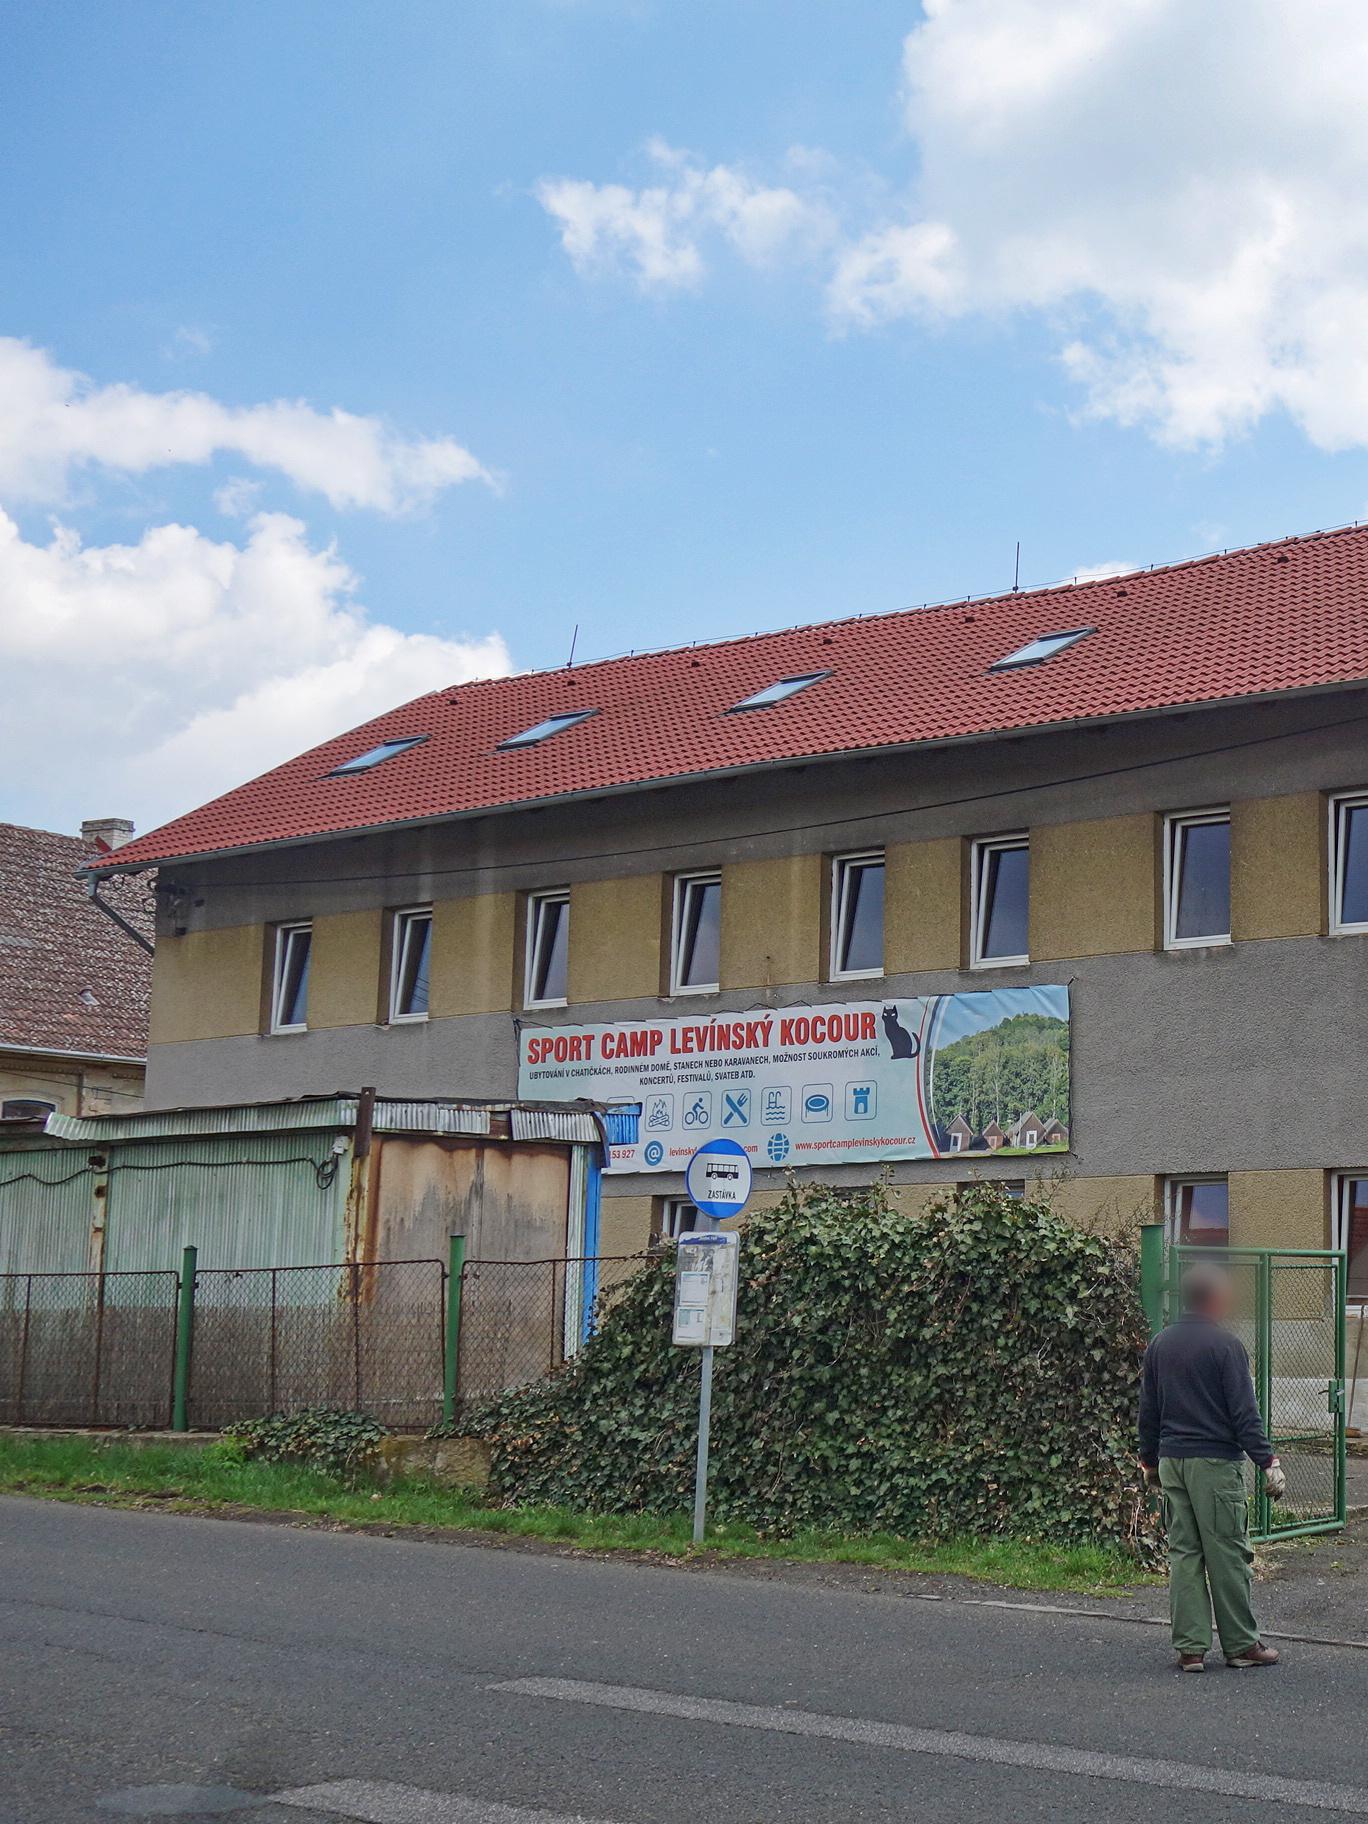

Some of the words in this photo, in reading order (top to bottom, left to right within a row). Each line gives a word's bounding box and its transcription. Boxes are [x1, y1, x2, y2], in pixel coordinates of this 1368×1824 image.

[527, 1034, 595, 1065] SPORT
[601, 1030, 663, 1060] CAMP
[670, 1013, 773, 1055] LEVÍNSKÝ
[780, 1011, 877, 1046] KOCOUR
[529, 1068, 565, 1080] UBYTOVÁNÍ
[565, 1070, 571, 1078] V
[571, 1065, 613, 1077] CHATIČKÁCH,
[614, 1062, 649, 1074] RODINNÉM
[673, 1060, 703, 1071] STANECH
[704, 1058, 723, 1068] NEBO
[724, 1056, 771, 1067] KARAVANECH,
[772, 1051, 807, 1063] MOŽNOST
[807, 1047, 859, 1061] SOUKROMÝCH
[715, 1070, 740, 1081] SVATEB
[740, 1069, 756, 1079] ATD.
[795, 1136, 916, 1151] www.sportcamplevinskykocour.cz
[621, 1149, 635, 1159] 927
[707, 1189, 736, 1200] ZASTÁVKA
